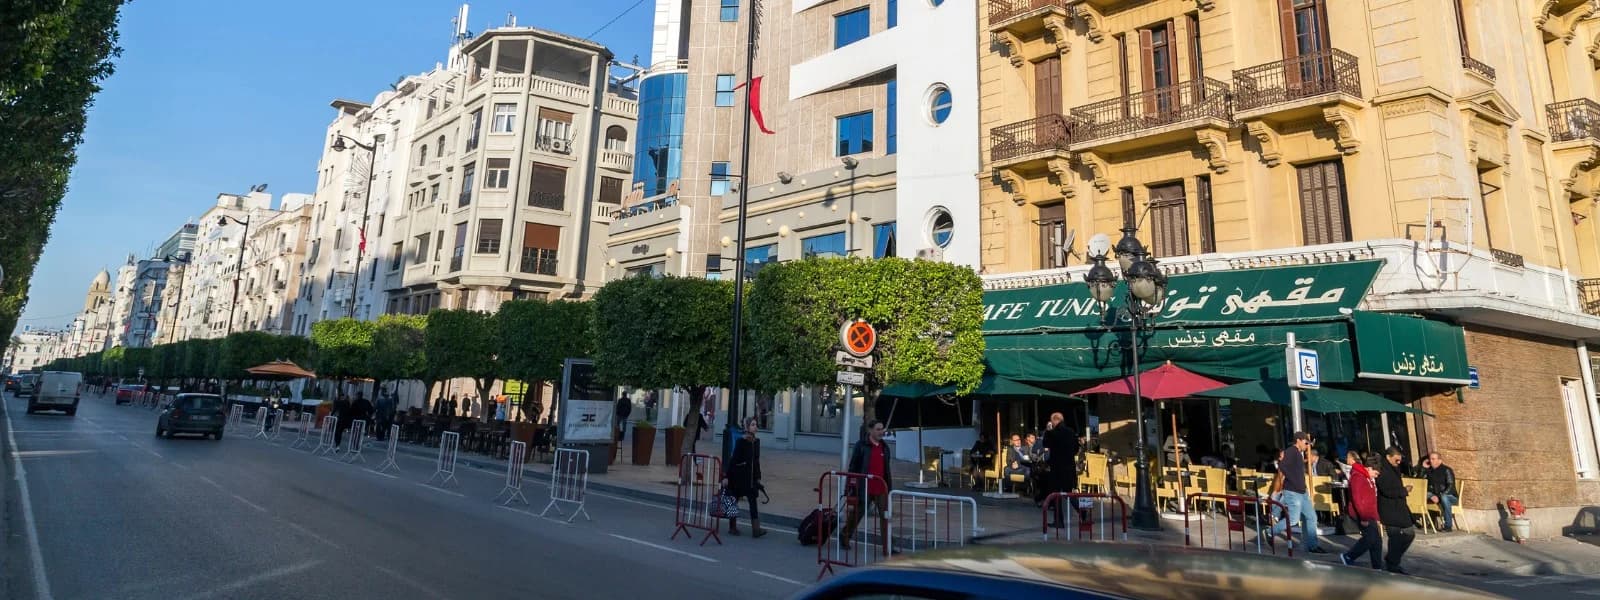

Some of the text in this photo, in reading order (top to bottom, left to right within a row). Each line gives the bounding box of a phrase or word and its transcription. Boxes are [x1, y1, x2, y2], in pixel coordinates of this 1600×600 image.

[982, 301, 1031, 321] AFE
[1168, 330, 1206, 347] تونس
[1392, 352, 1417, 375] تونس
